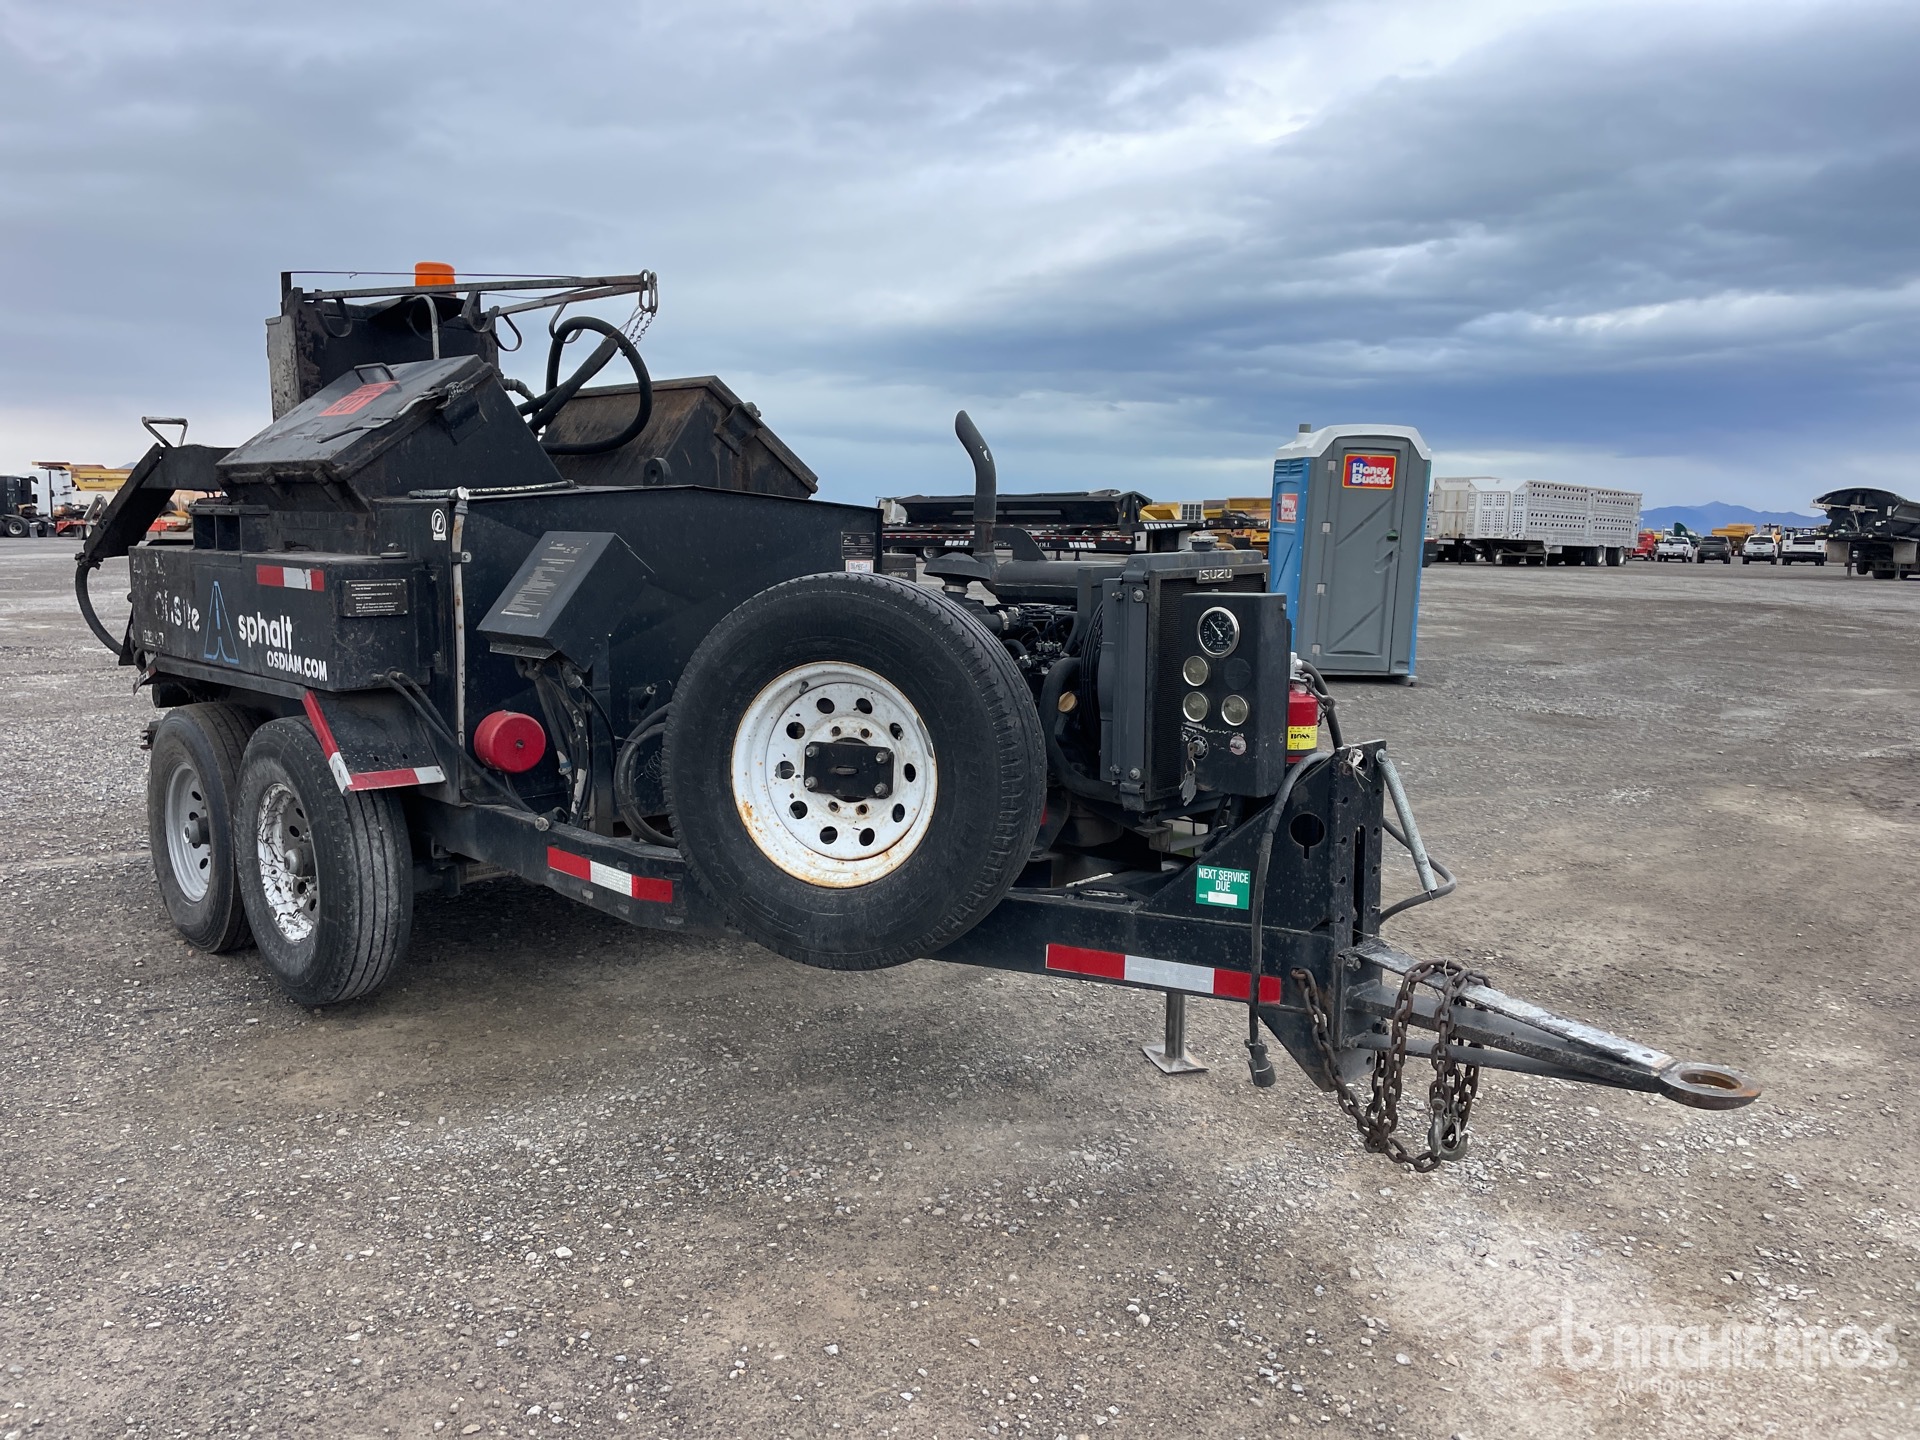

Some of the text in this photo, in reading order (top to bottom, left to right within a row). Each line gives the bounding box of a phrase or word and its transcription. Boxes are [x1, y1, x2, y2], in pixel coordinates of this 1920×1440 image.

[1352, 462, 1390, 477] Honey
[1351, 473, 1392, 485] Bucket
[1198, 568, 1233, 581] ISUZU
[266, 650, 328, 682] OSDIAM.COM
[1198, 867, 1249, 884] NEXT SERVICE
[1215, 880, 1231, 892] DUE
